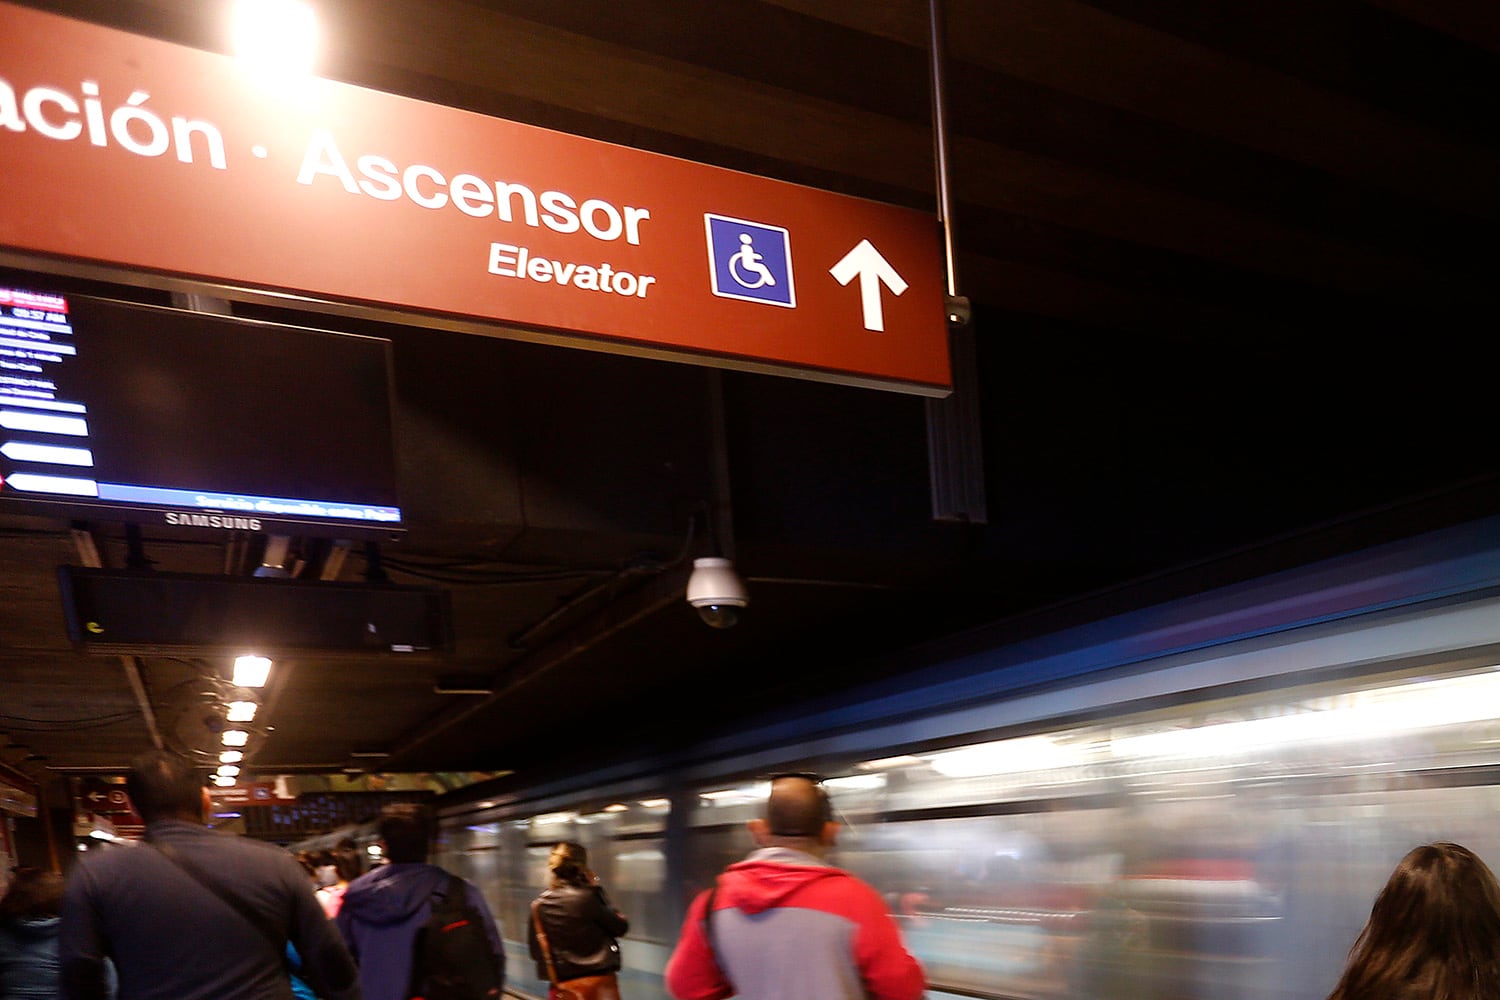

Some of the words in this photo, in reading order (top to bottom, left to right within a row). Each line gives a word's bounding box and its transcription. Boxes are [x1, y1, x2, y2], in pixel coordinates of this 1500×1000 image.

[296, 127, 650, 246] Ascensor
[488, 242, 656, 298] Elevator
[165, 512, 262, 531] SAMSUNG
